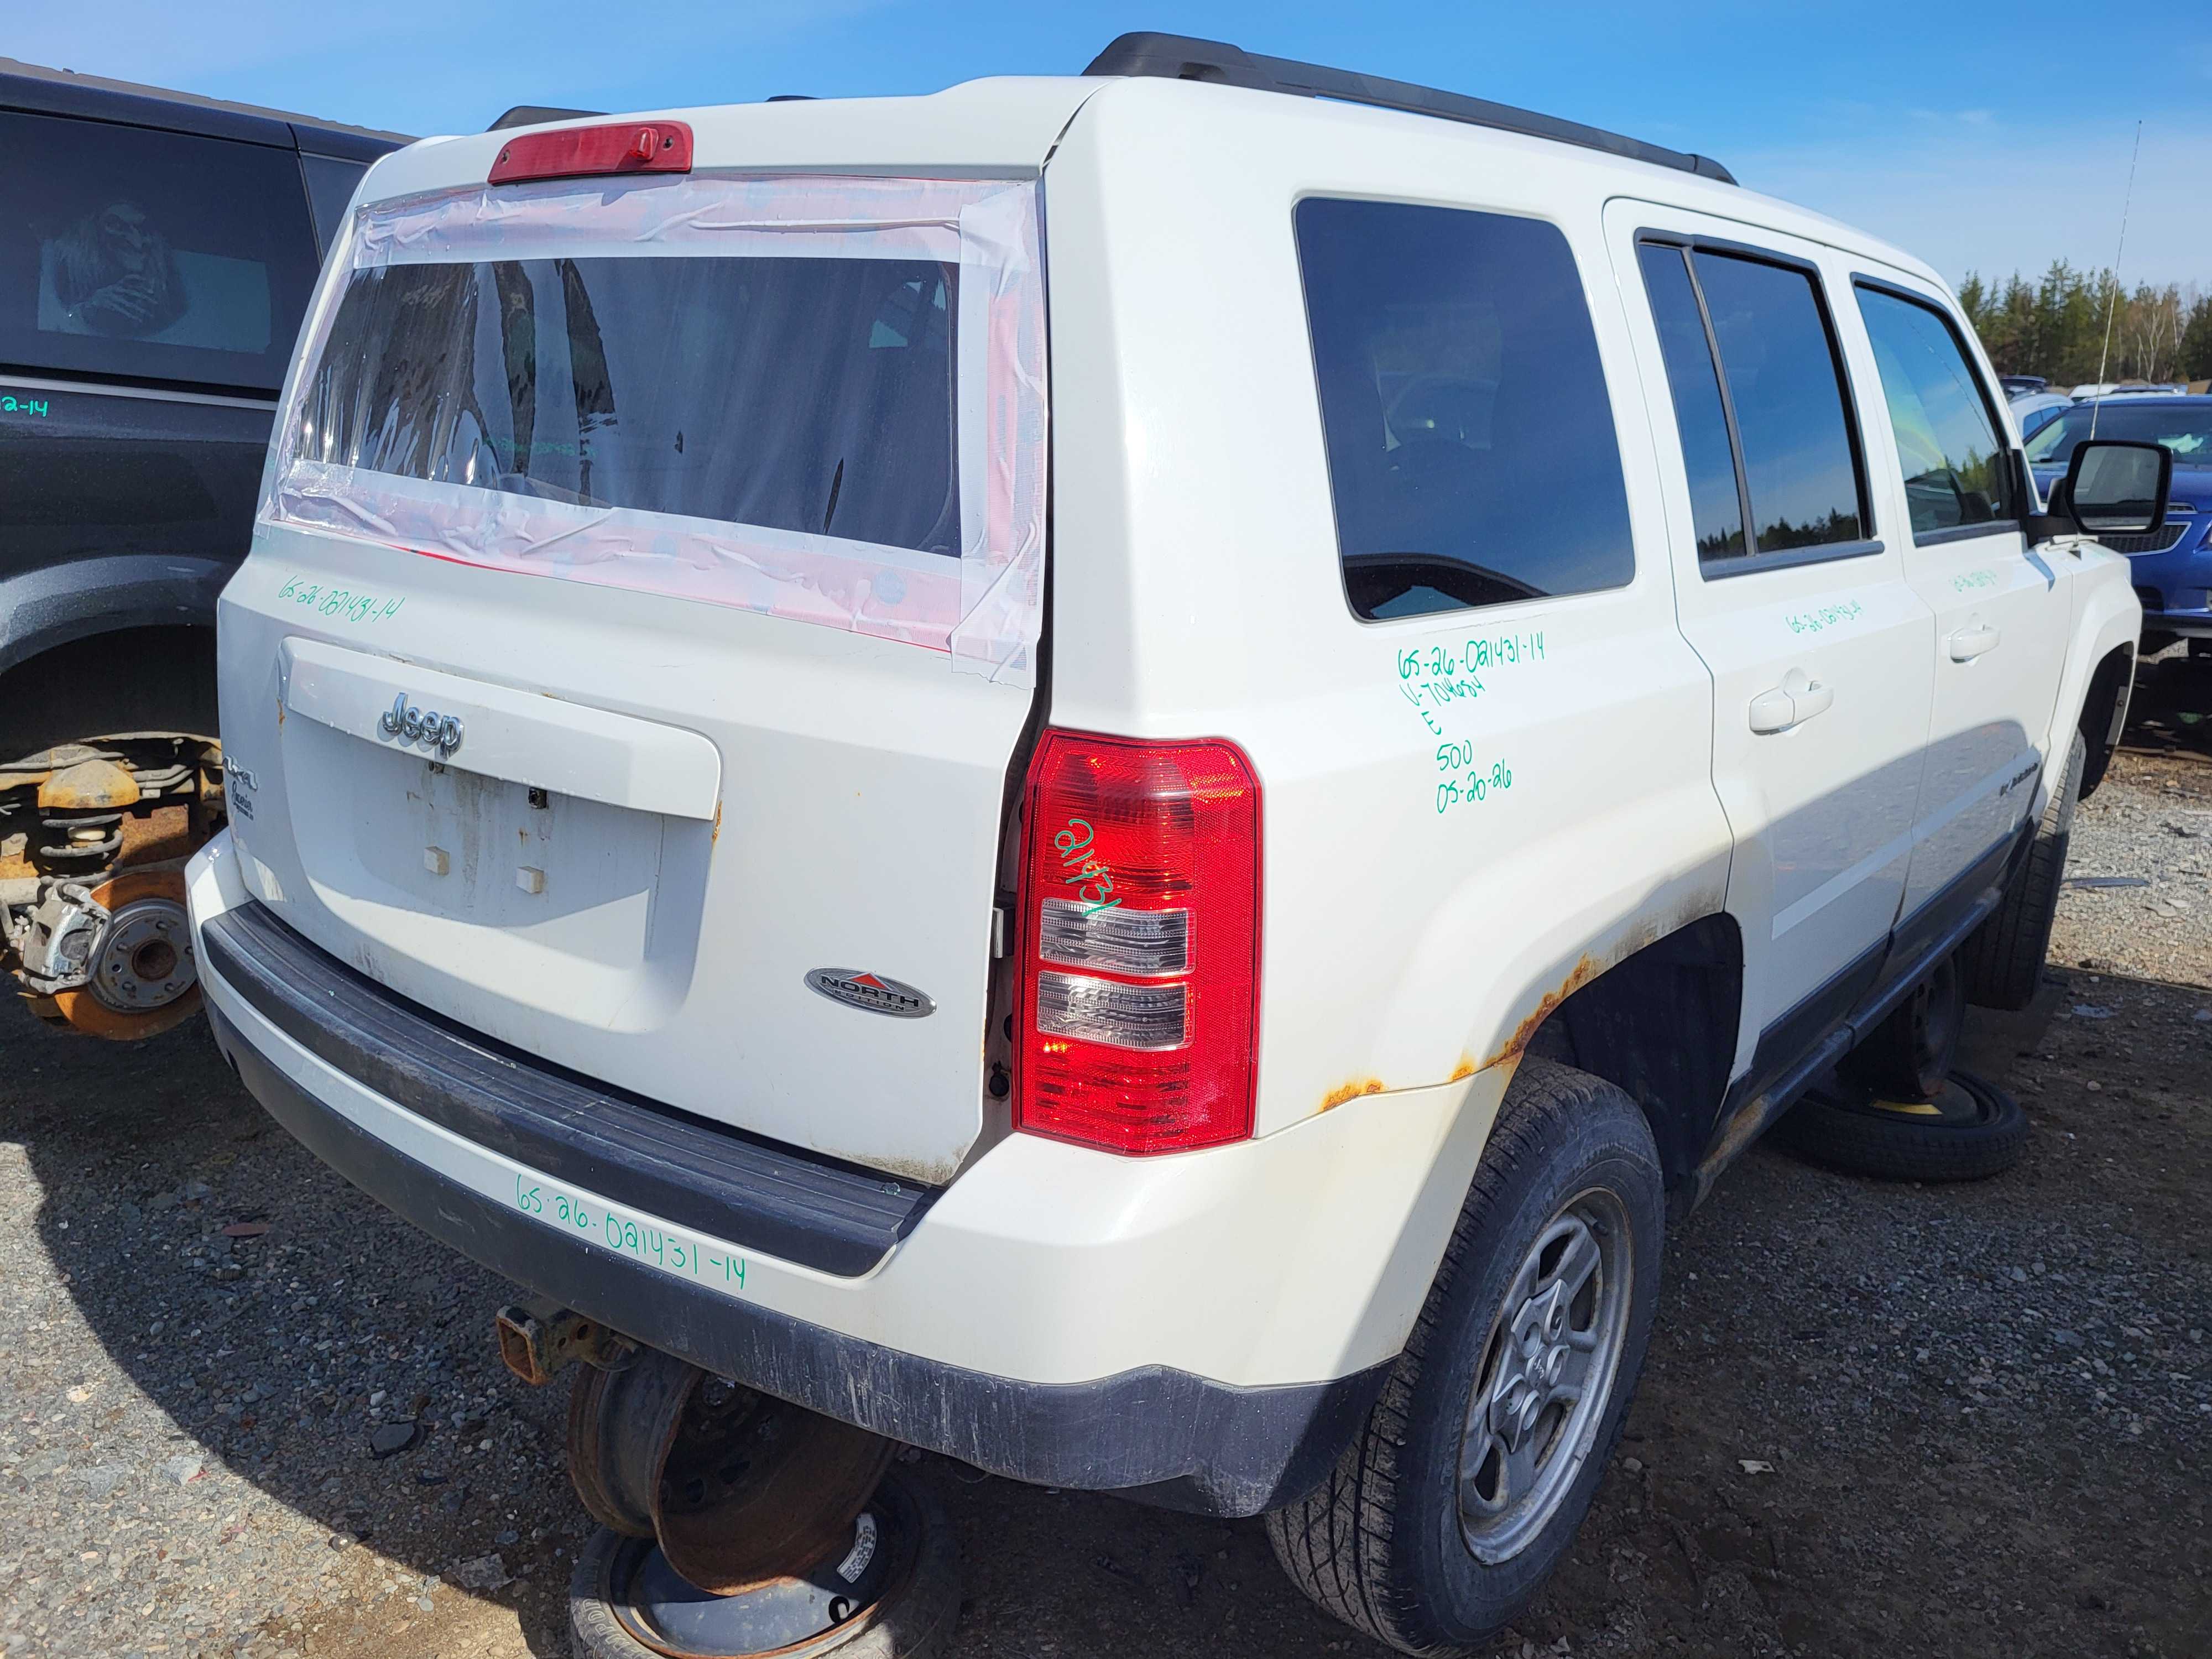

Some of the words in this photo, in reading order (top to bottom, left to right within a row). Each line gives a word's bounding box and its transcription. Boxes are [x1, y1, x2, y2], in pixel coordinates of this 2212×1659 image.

[0, 395, 49, 417] 2-14
[1398, 631, 1545, 679] 65-26-021431-14
[382, 692, 465, 761] Jeep
[1437, 740, 1472, 771] 500
[1437, 758, 1512, 813] 05-20-26
[821, 976, 919, 1008] NORTH
[834, 990, 905, 1010] EDITION
